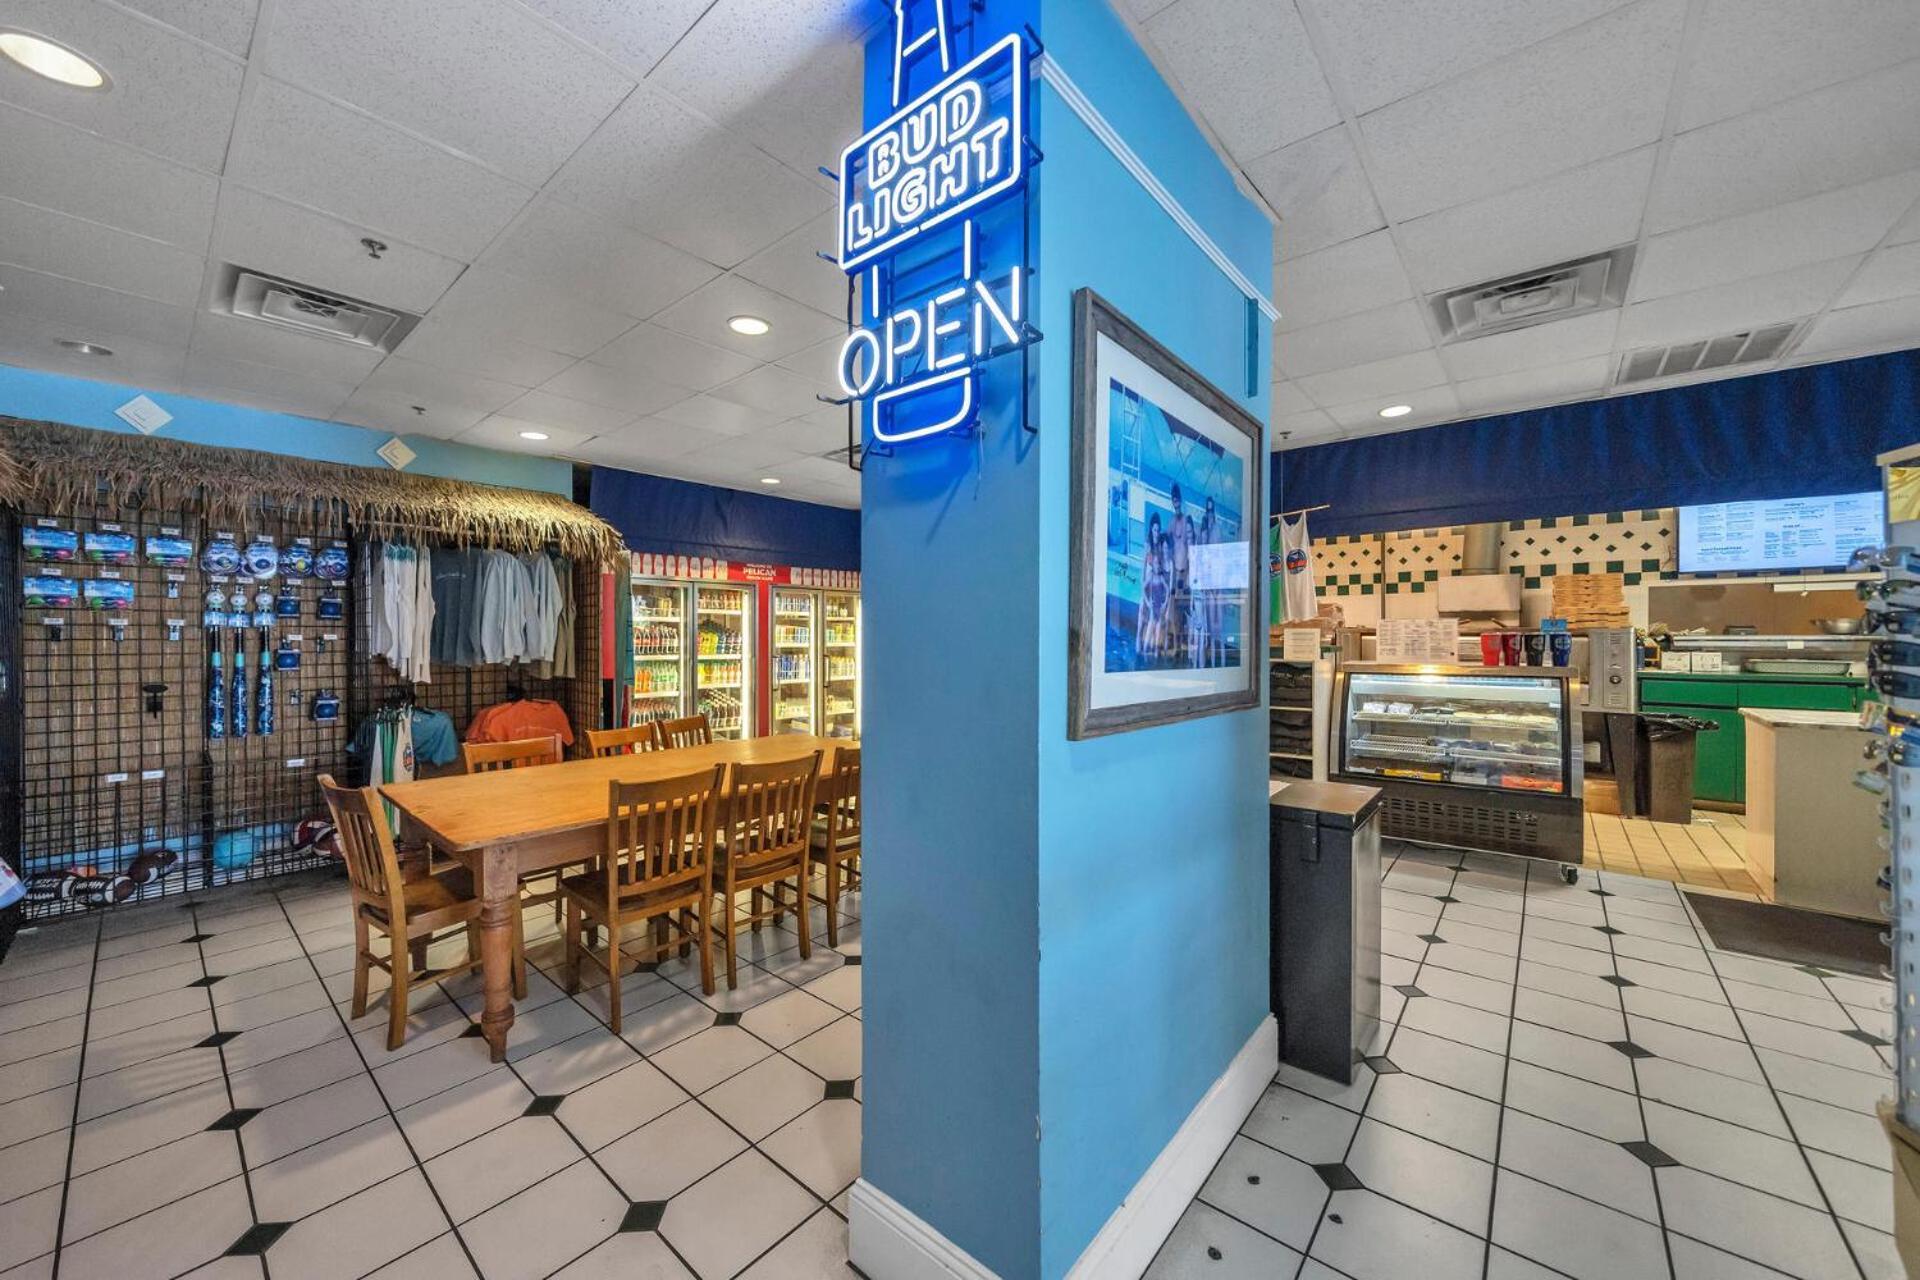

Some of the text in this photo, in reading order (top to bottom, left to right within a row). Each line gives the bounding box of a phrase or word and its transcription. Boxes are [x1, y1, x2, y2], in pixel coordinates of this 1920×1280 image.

[847, 117, 1009, 253] LIGHT
[868, 80, 982, 188] BUD
[838, 266, 1020, 397] OPEN
[743, 567, 777, 577] PELICAN
